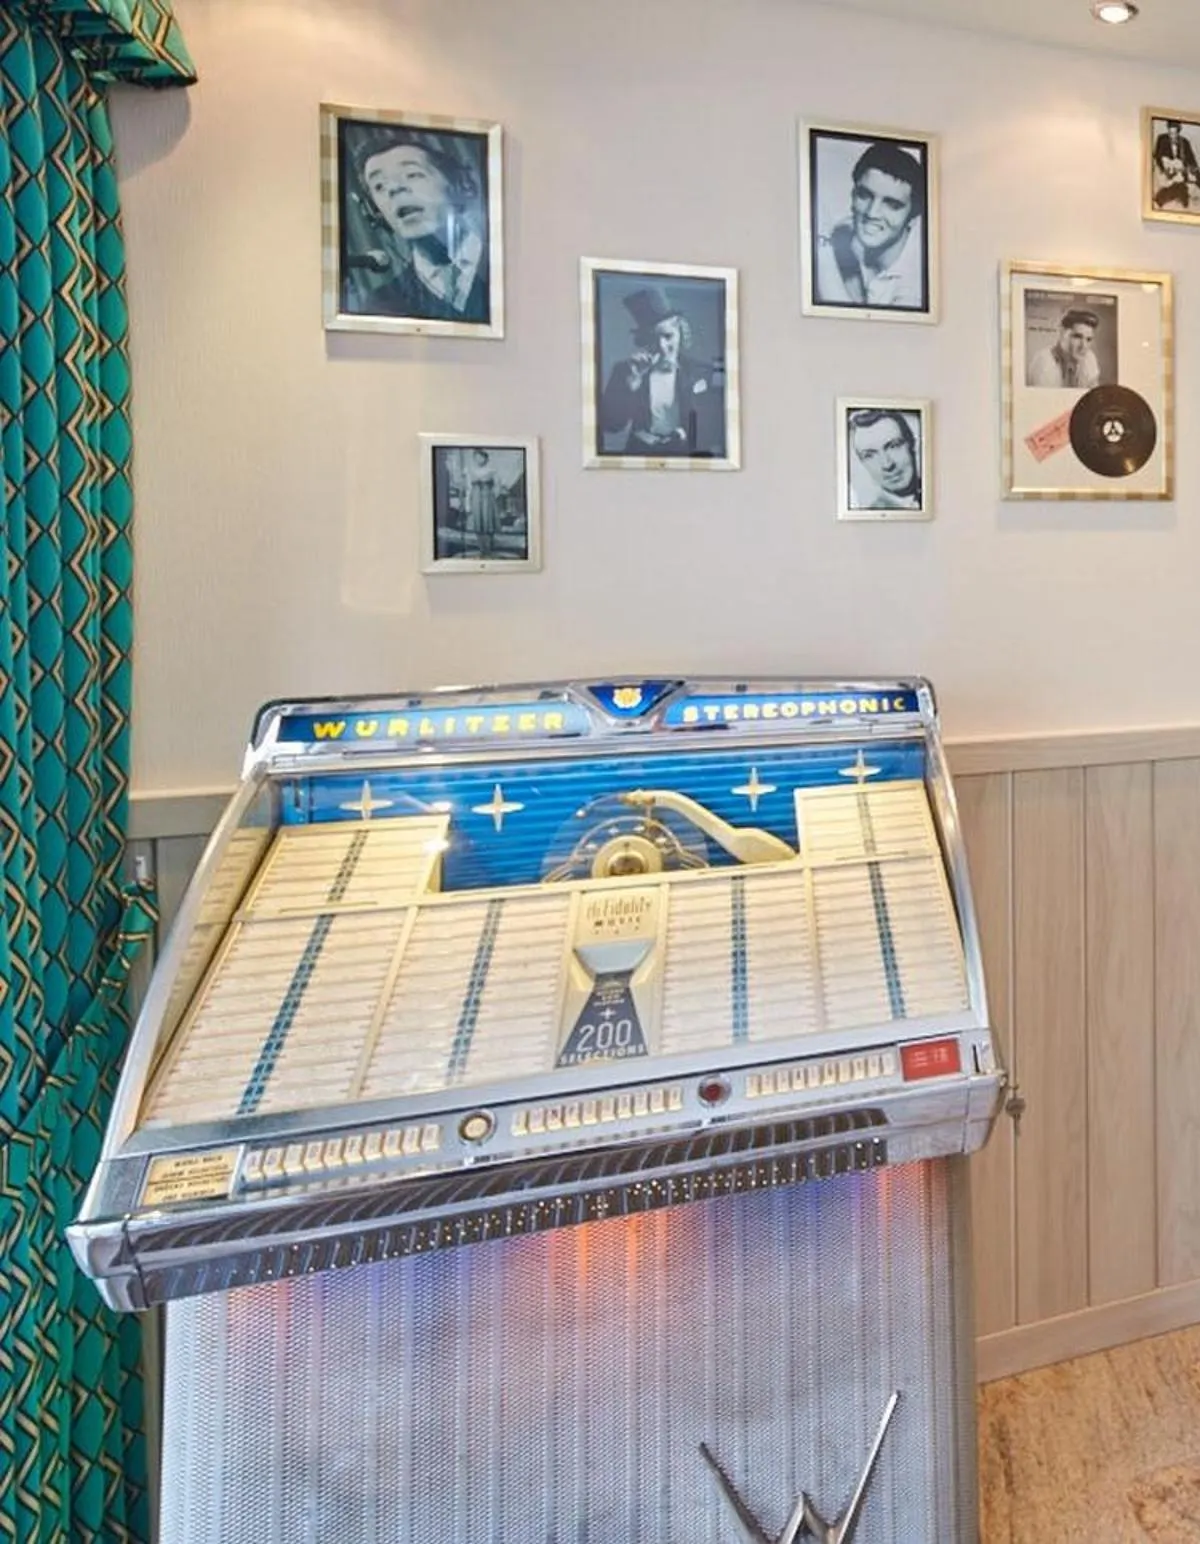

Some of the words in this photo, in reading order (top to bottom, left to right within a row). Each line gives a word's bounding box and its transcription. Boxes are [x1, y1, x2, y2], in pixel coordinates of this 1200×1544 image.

[683, 697, 906, 723] STEREOPHONIC
[312, 711, 566, 739] WURLITZER
[576, 1019, 632, 1052] 200
